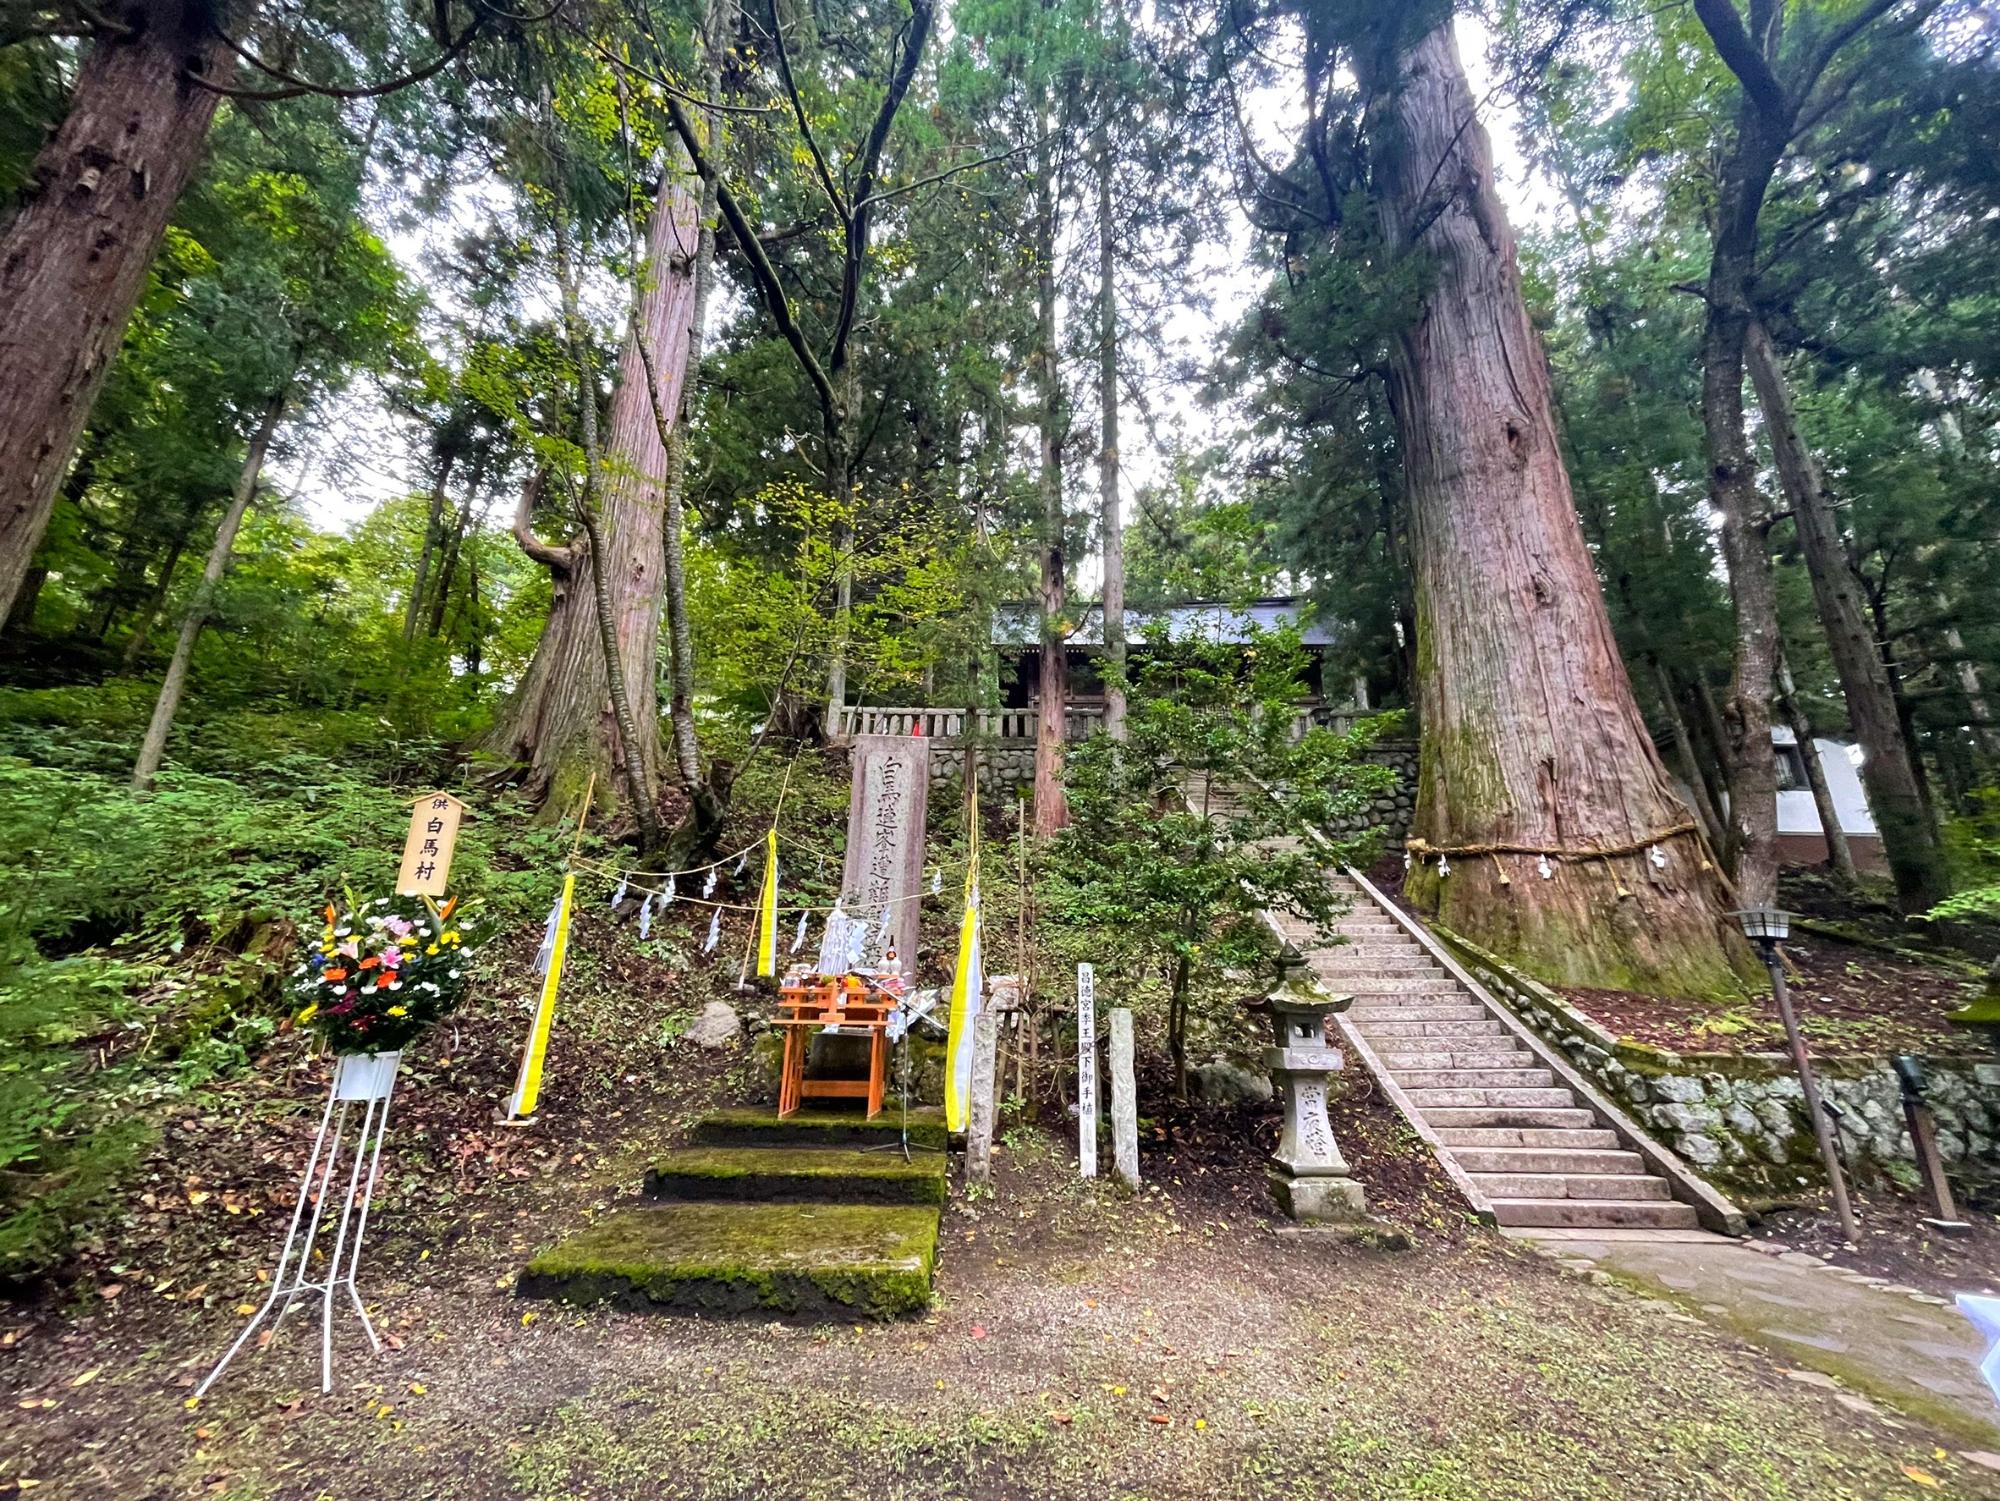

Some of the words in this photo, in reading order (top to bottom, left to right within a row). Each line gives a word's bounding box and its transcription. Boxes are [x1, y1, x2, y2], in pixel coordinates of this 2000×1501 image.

[432, 798, 449, 810] 供
[414, 817, 444, 881] 白馬村
